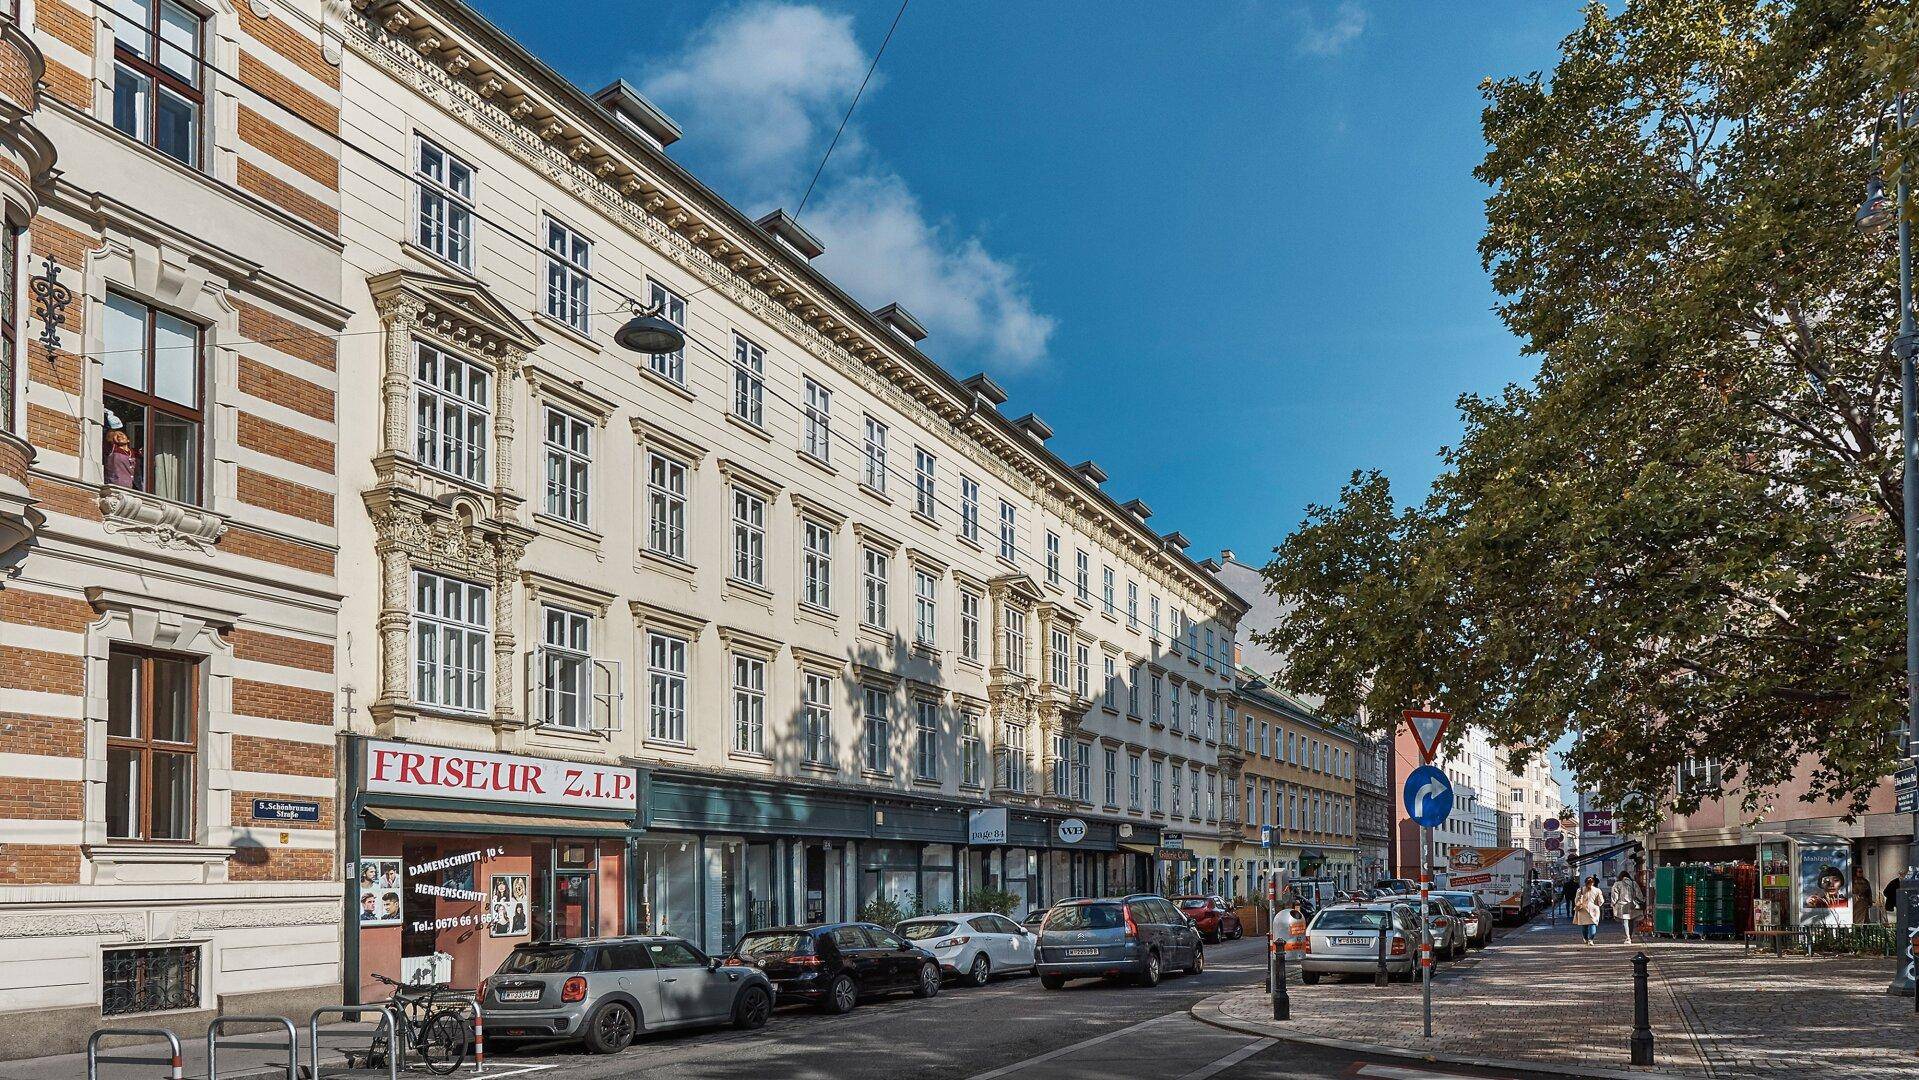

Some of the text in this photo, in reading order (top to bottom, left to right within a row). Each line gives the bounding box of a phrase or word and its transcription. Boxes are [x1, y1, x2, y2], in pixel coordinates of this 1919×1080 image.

[369, 749, 636, 801] FRISEUR Z.I.P.
[276, 810, 299, 819] Straße
[971, 829, 1005, 840] page 84
[1061, 826, 1084, 836] WB
[408, 850, 482, 877] DAMENSCHNITT
[487, 848, 496, 858] 10
[415, 883, 488, 903] HERRENSCHNITT
[413, 921, 434, 932] Tel.:
[435, 916, 458, 930] 0676
[459, 914, 472, 927] 66
[473, 914, 480, 926] 1
